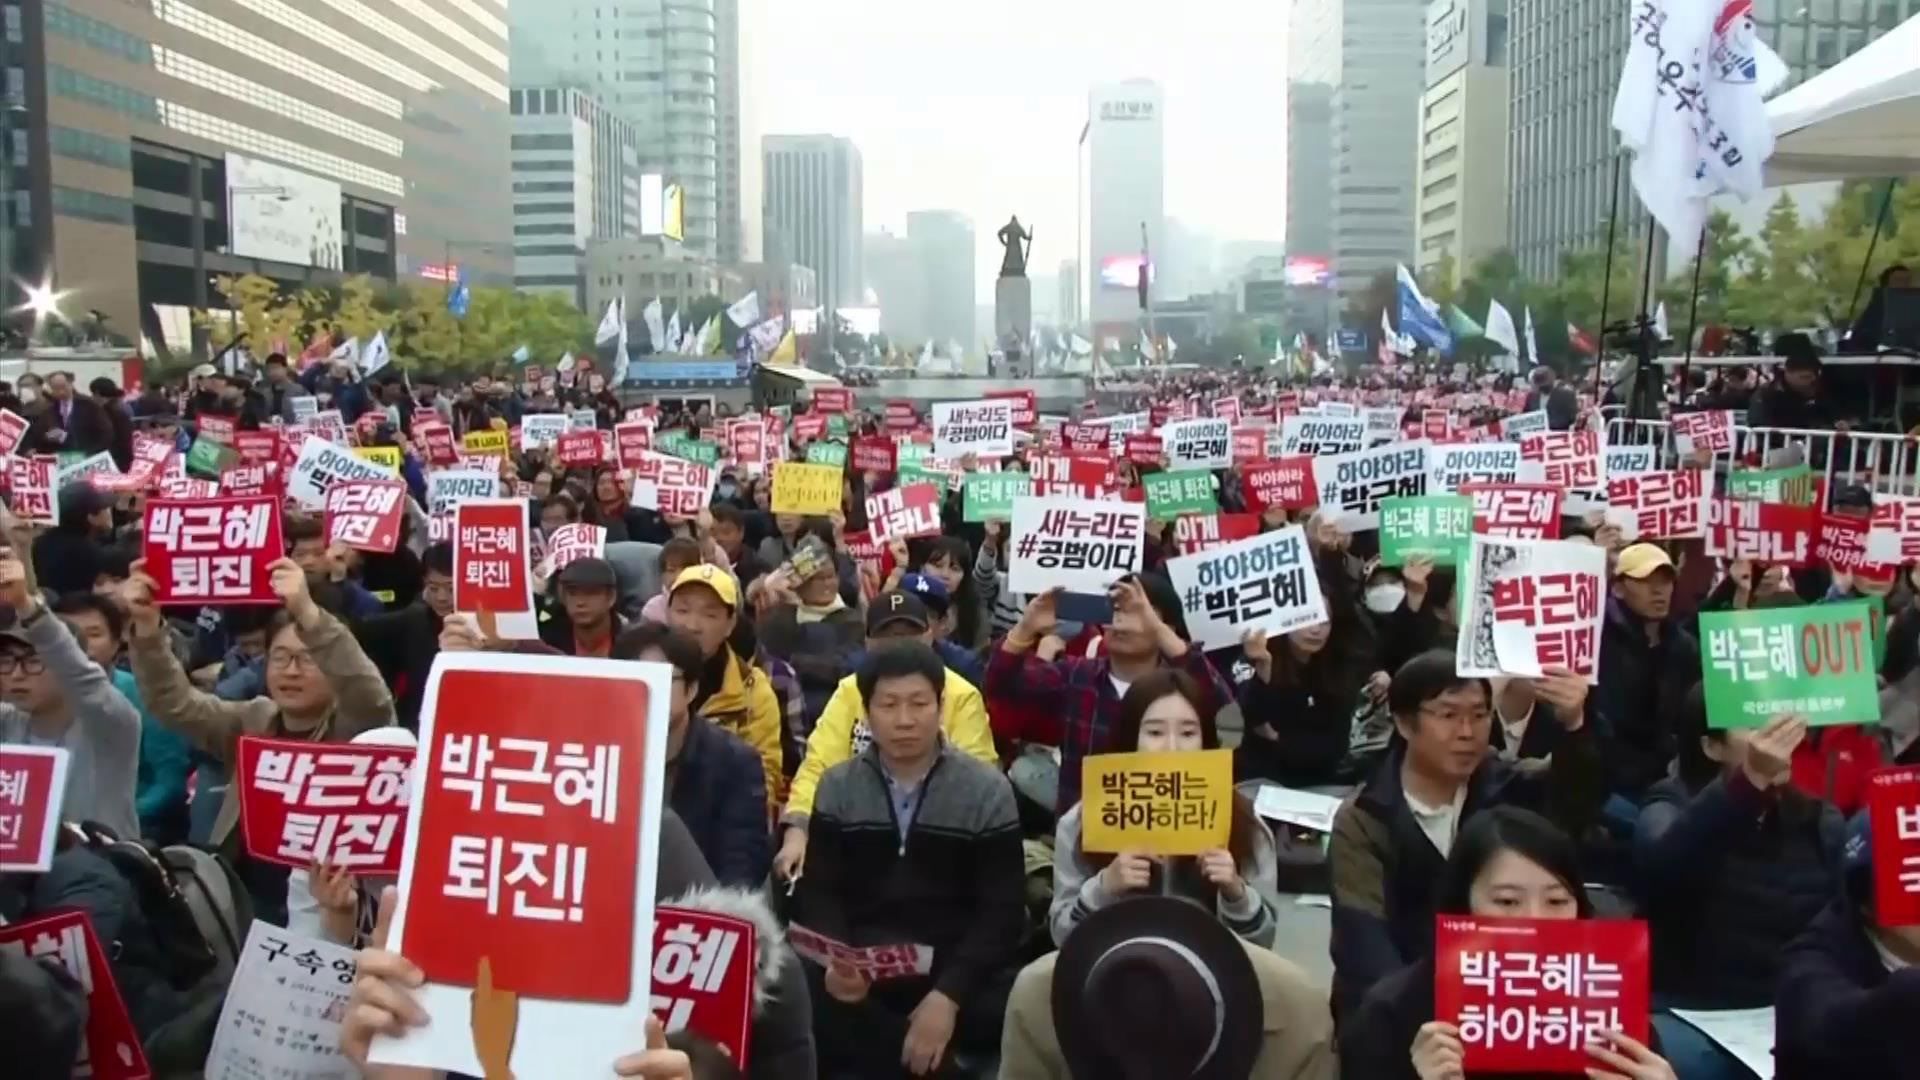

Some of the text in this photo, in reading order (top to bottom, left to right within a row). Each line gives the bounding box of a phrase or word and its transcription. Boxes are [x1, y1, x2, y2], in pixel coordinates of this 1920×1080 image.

[948, 406, 1007, 423] 새누리도
[938, 423, 1008, 443] #공범이다
[1175, 423, 1228, 440] 하야하라
[1300, 422, 1364, 440] 하야하라
[1521, 431, 1598, 461] 박근혜
[638, 459, 709, 489] 박근혜
[1030, 456, 1070, 482] 이게
[1337, 447, 1425, 483] 하야하라
[1445, 450, 1517, 469] 하야하라
[1545, 459, 1598, 487] 퇴진
[1249, 468, 1306, 488] 하야하라
[1256, 484, 1303, 503] 박근혜!
[1607, 467, 1703, 510] 박근혜
[657, 488, 704, 516] 퇴진
[864, 487, 904, 520] 이게
[1472, 490, 1557, 524] 박근혜
[1708, 498, 1760, 529] 이게
[148, 502, 272, 552] 박근혜
[1038, 509, 1140, 540] 새누리도
[1175, 514, 1220, 541] 이게
[1383, 506, 1430, 539] 박근혜
[1435, 505, 1469, 539] 퇴진
[1638, 502, 1698, 539] 퇴진
[461, 526, 518, 555] 박근혜
[1016, 533, 1137, 573] #공범이다
[170, 555, 252, 596] 퇴진
[464, 560, 512, 588] 퇴진!
[1198, 536, 1300, 587] 하야하라
[890, 594, 904, 611] P
[1184, 567, 1307, 625] #박근혜
[1492, 573, 1599, 627] 박근혜
[1709, 620, 1863, 683] 박근혜 OUT
[253, 749, 414, 808] 박근혜
[440, 732, 621, 824] 박근혜
[1101, 770, 1209, 801] 박근혜는
[1101, 800, 1217, 831] 하야하라!
[276, 811, 402, 866] 퇴진
[442, 833, 589, 923] 퇴진!
[1459, 949, 1623, 998] 박근혜는
[1457, 1003, 1624, 1053] 하야하라
